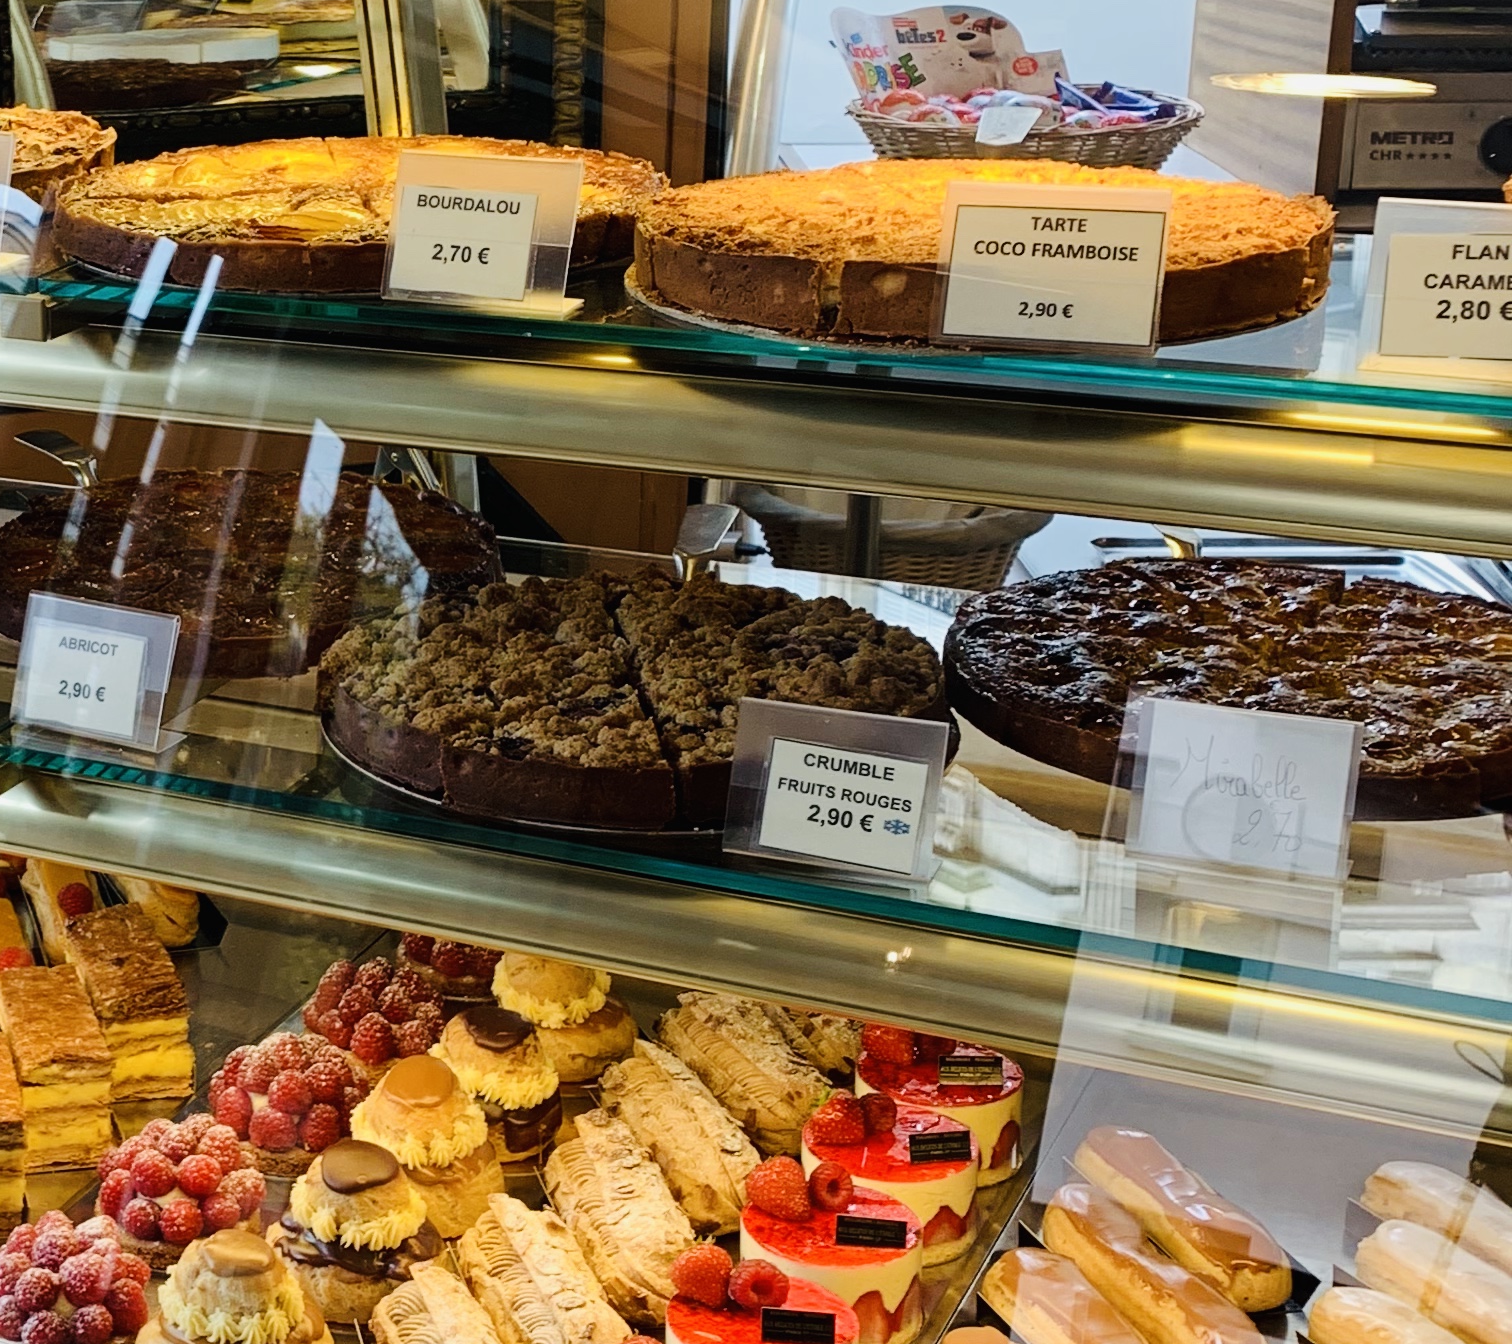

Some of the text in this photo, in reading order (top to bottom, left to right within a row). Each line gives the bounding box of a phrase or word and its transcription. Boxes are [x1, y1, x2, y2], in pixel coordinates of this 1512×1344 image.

[1371, 131, 1454, 145] METRO
[1369, 149, 1402, 161] CHR
[417, 194, 521, 215] BOURDALOU
[1031, 216, 1088, 233] TARTE
[431, 243, 491, 265] 2,70 €
[974, 240, 1139, 262] COCO FRAMBOISE
[1452, 244, 1510, 260] FLAN
[1018, 301, 1074, 319] 2,90 €
[1436, 299, 1512, 323] 2,80 €
[59, 636, 119, 657] ABRICOT
[59, 679, 106, 702] 2,90 €
[803, 753, 895, 782] CRUMBLE
[1170, 735, 1307, 801] Mirabelle
[777, 777, 912, 813] FRUITS ROUGES
[807, 804, 875, 832] 2,90 €
